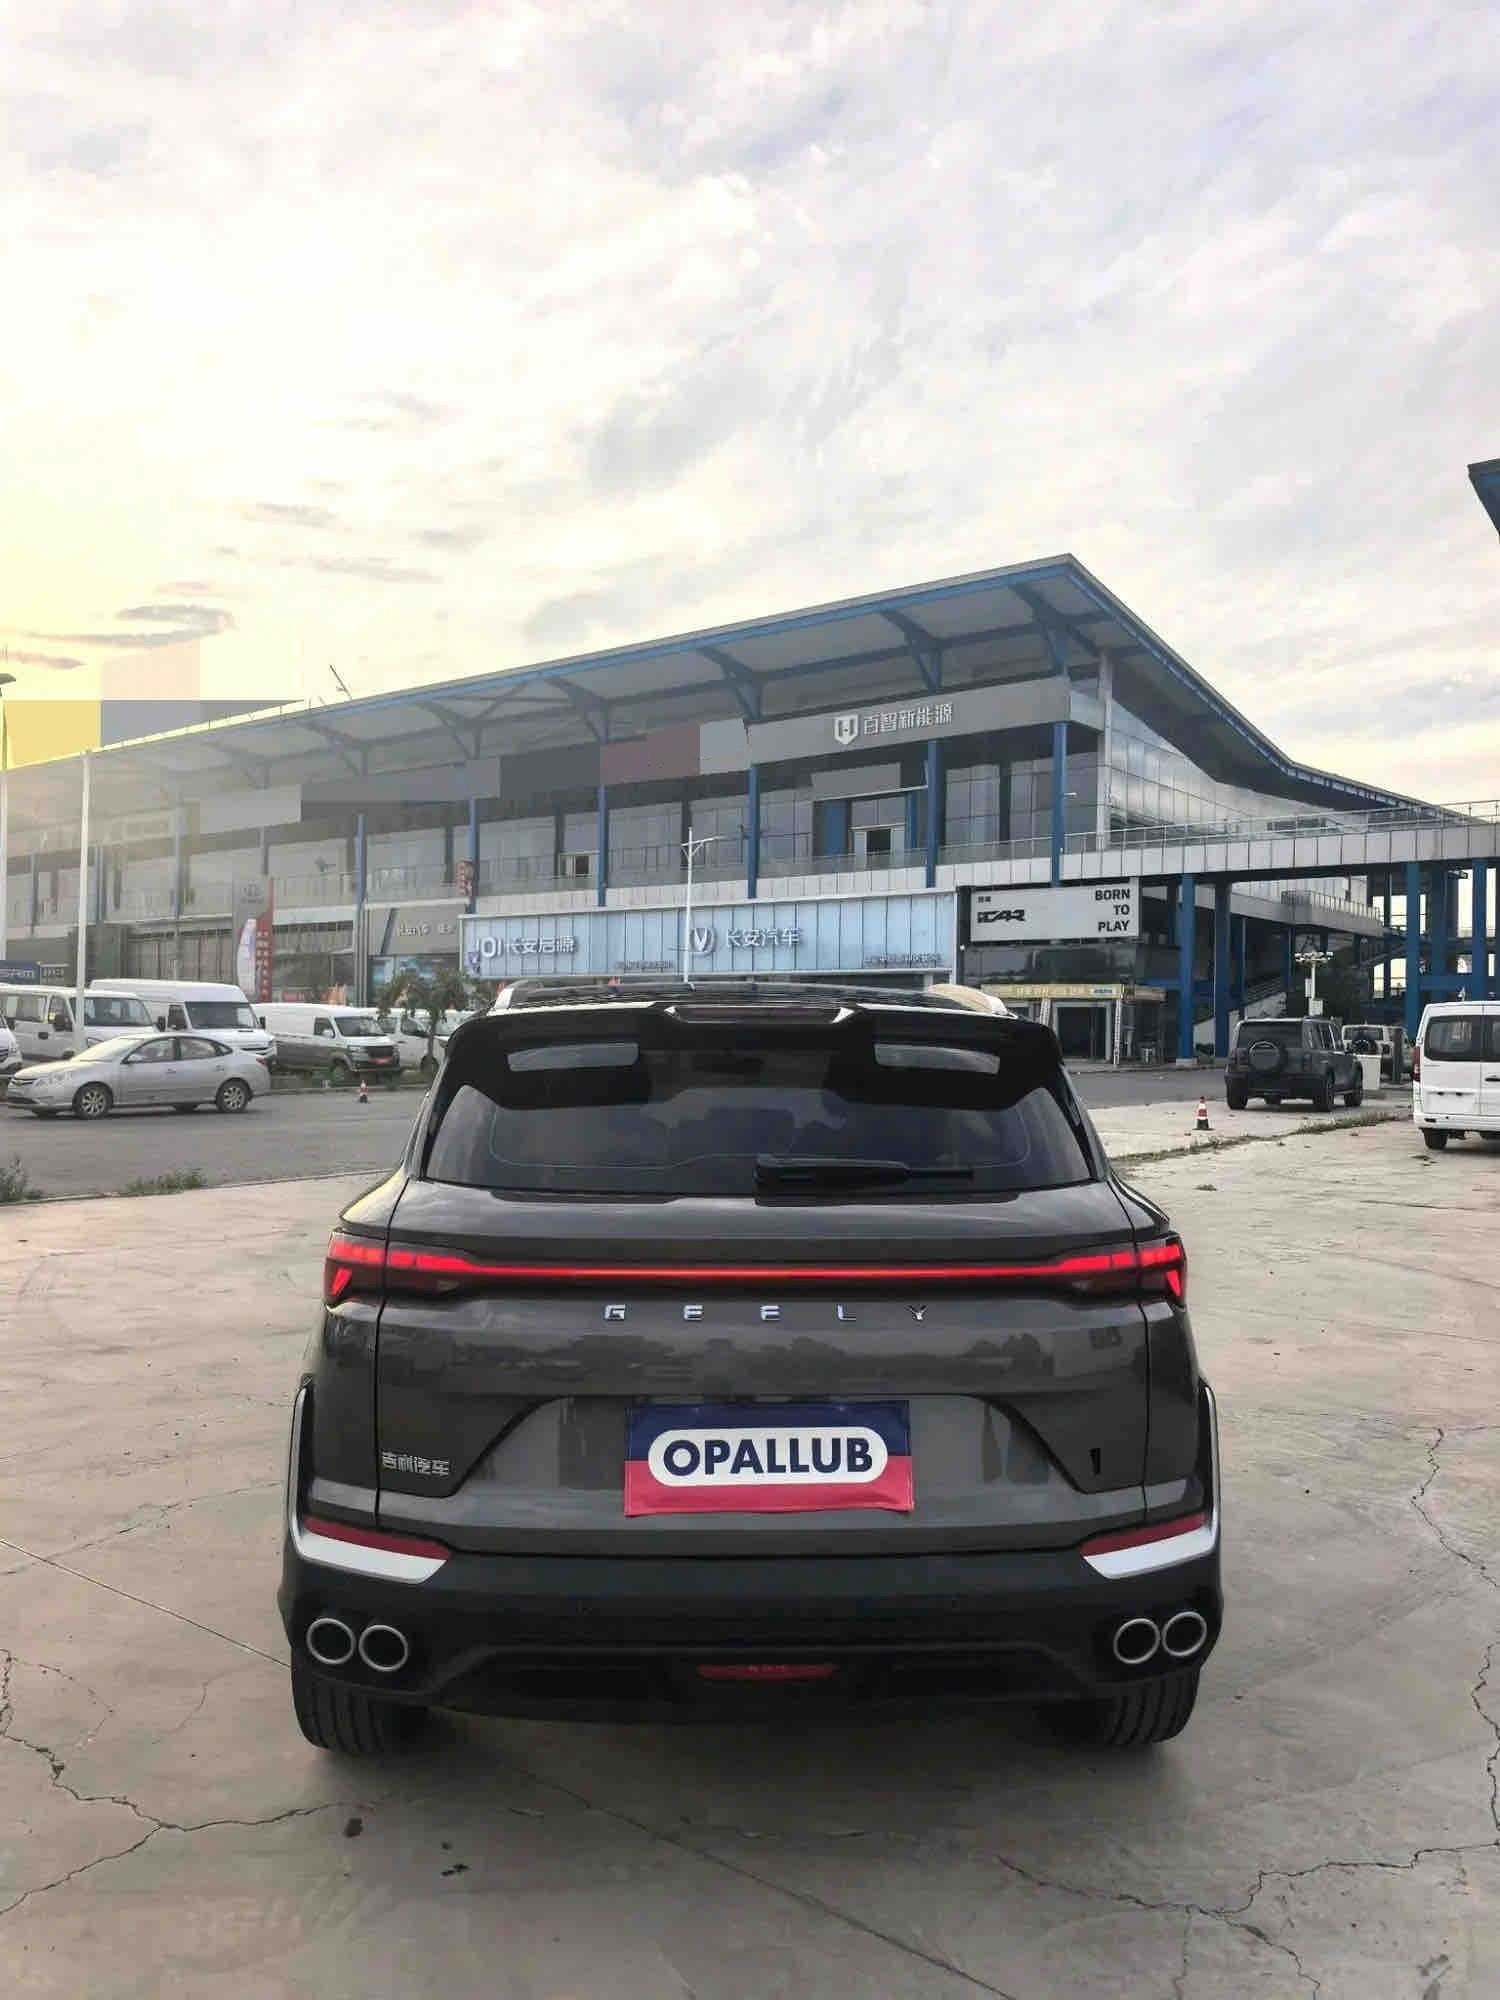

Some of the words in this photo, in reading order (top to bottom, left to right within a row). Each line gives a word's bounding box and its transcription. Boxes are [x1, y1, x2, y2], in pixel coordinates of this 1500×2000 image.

[1095, 888, 1130, 901] BORN
[1113, 904, 1130, 916] TO
[1097, 920, 1130, 933] PLAY
[726, 927, 801, 948] 长安汽车
[604, 1304, 929, 1321] GEELY
[663, 1437, 873, 1476] OPALLUB
